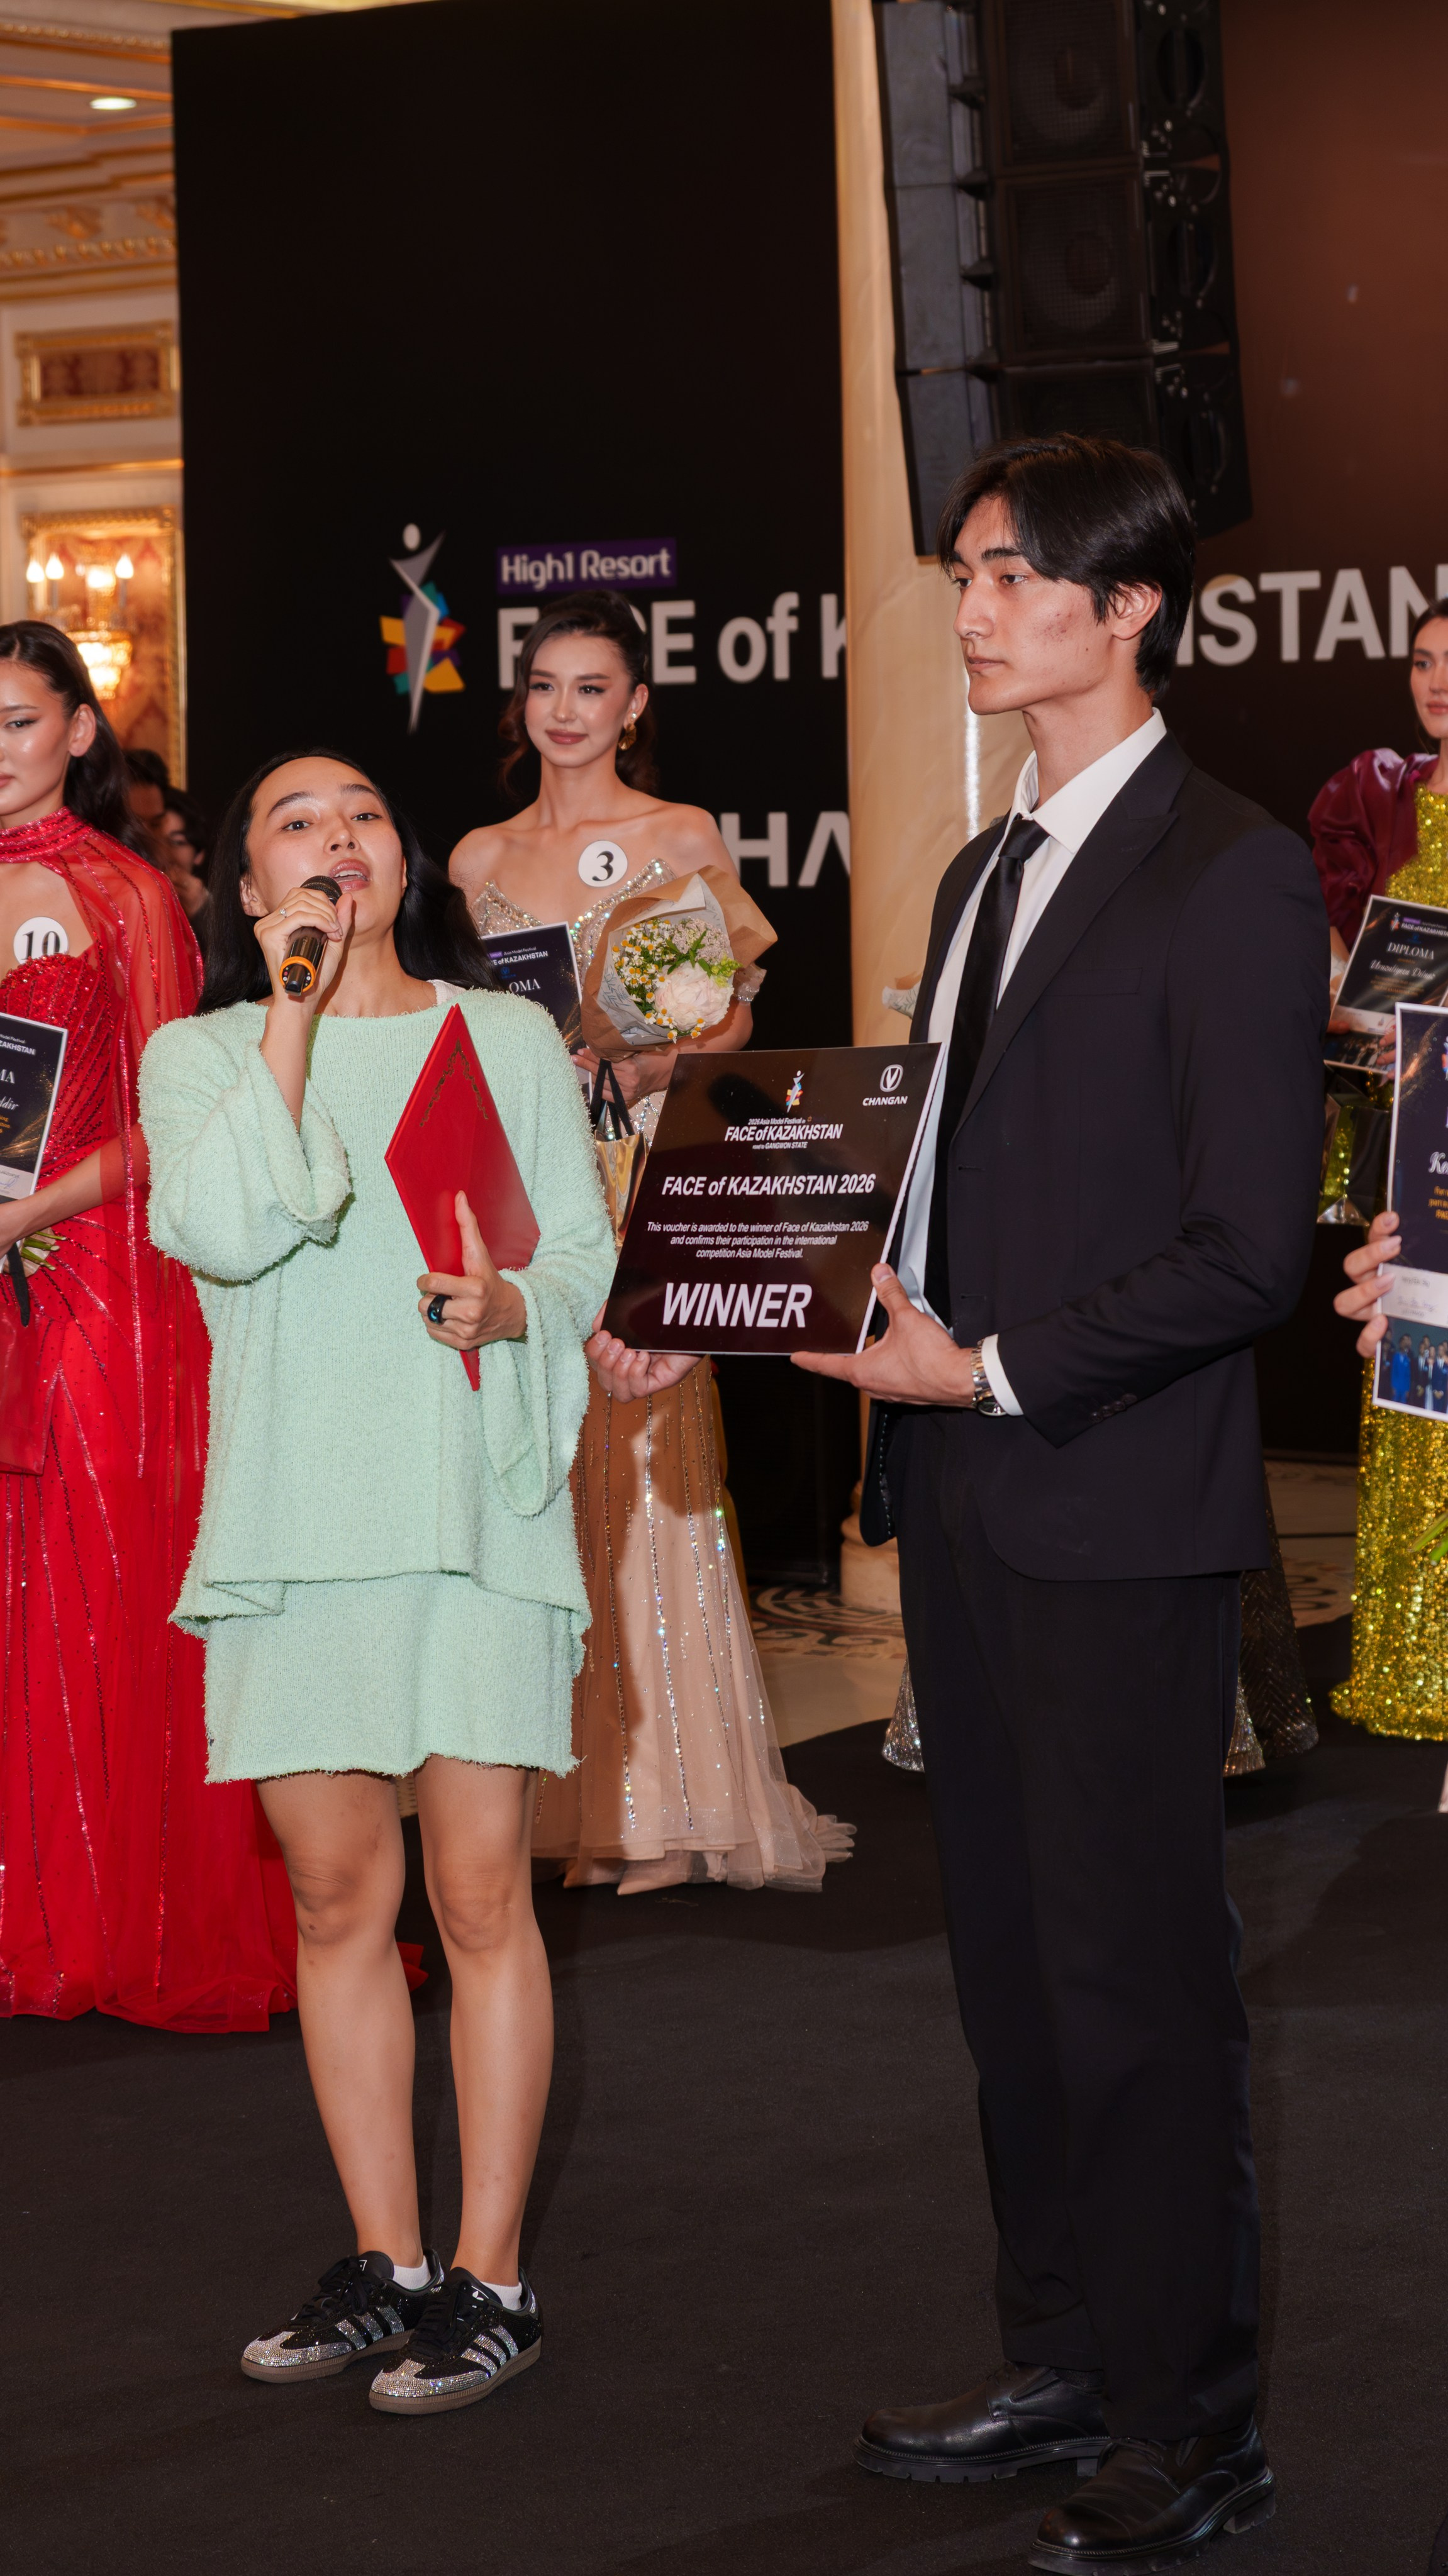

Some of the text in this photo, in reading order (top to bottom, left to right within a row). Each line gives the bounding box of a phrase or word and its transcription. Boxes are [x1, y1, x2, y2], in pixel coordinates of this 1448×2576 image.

[501, 547, 671, 592] High1 Resort
[498, 599, 696, 690] FE
[717, 591, 799, 684] of
[592, 850, 614, 882] 3
[21, 930, 60, 960] 10
[1387, 941, 1434, 960] DIPLOMA
[504, 950, 549, 964] KAZAKHSTAN
[862, 1096, 908, 1106] CHANGAN
[725, 1123, 844, 1141] FACE of KAZAKHSTAN
[661, 1173, 876, 1196] FACE of KAZAKHSTAN 2026
[647, 1221, 869, 1233] This voucher is awarded to the winner of Face of Kazakhstan 2026
[671, 1235, 838, 1246] and confirms their participation in the international
[696, 1248, 803, 1259] competition Asia Model Festival.
[662, 1282, 813, 1328] WINNER
